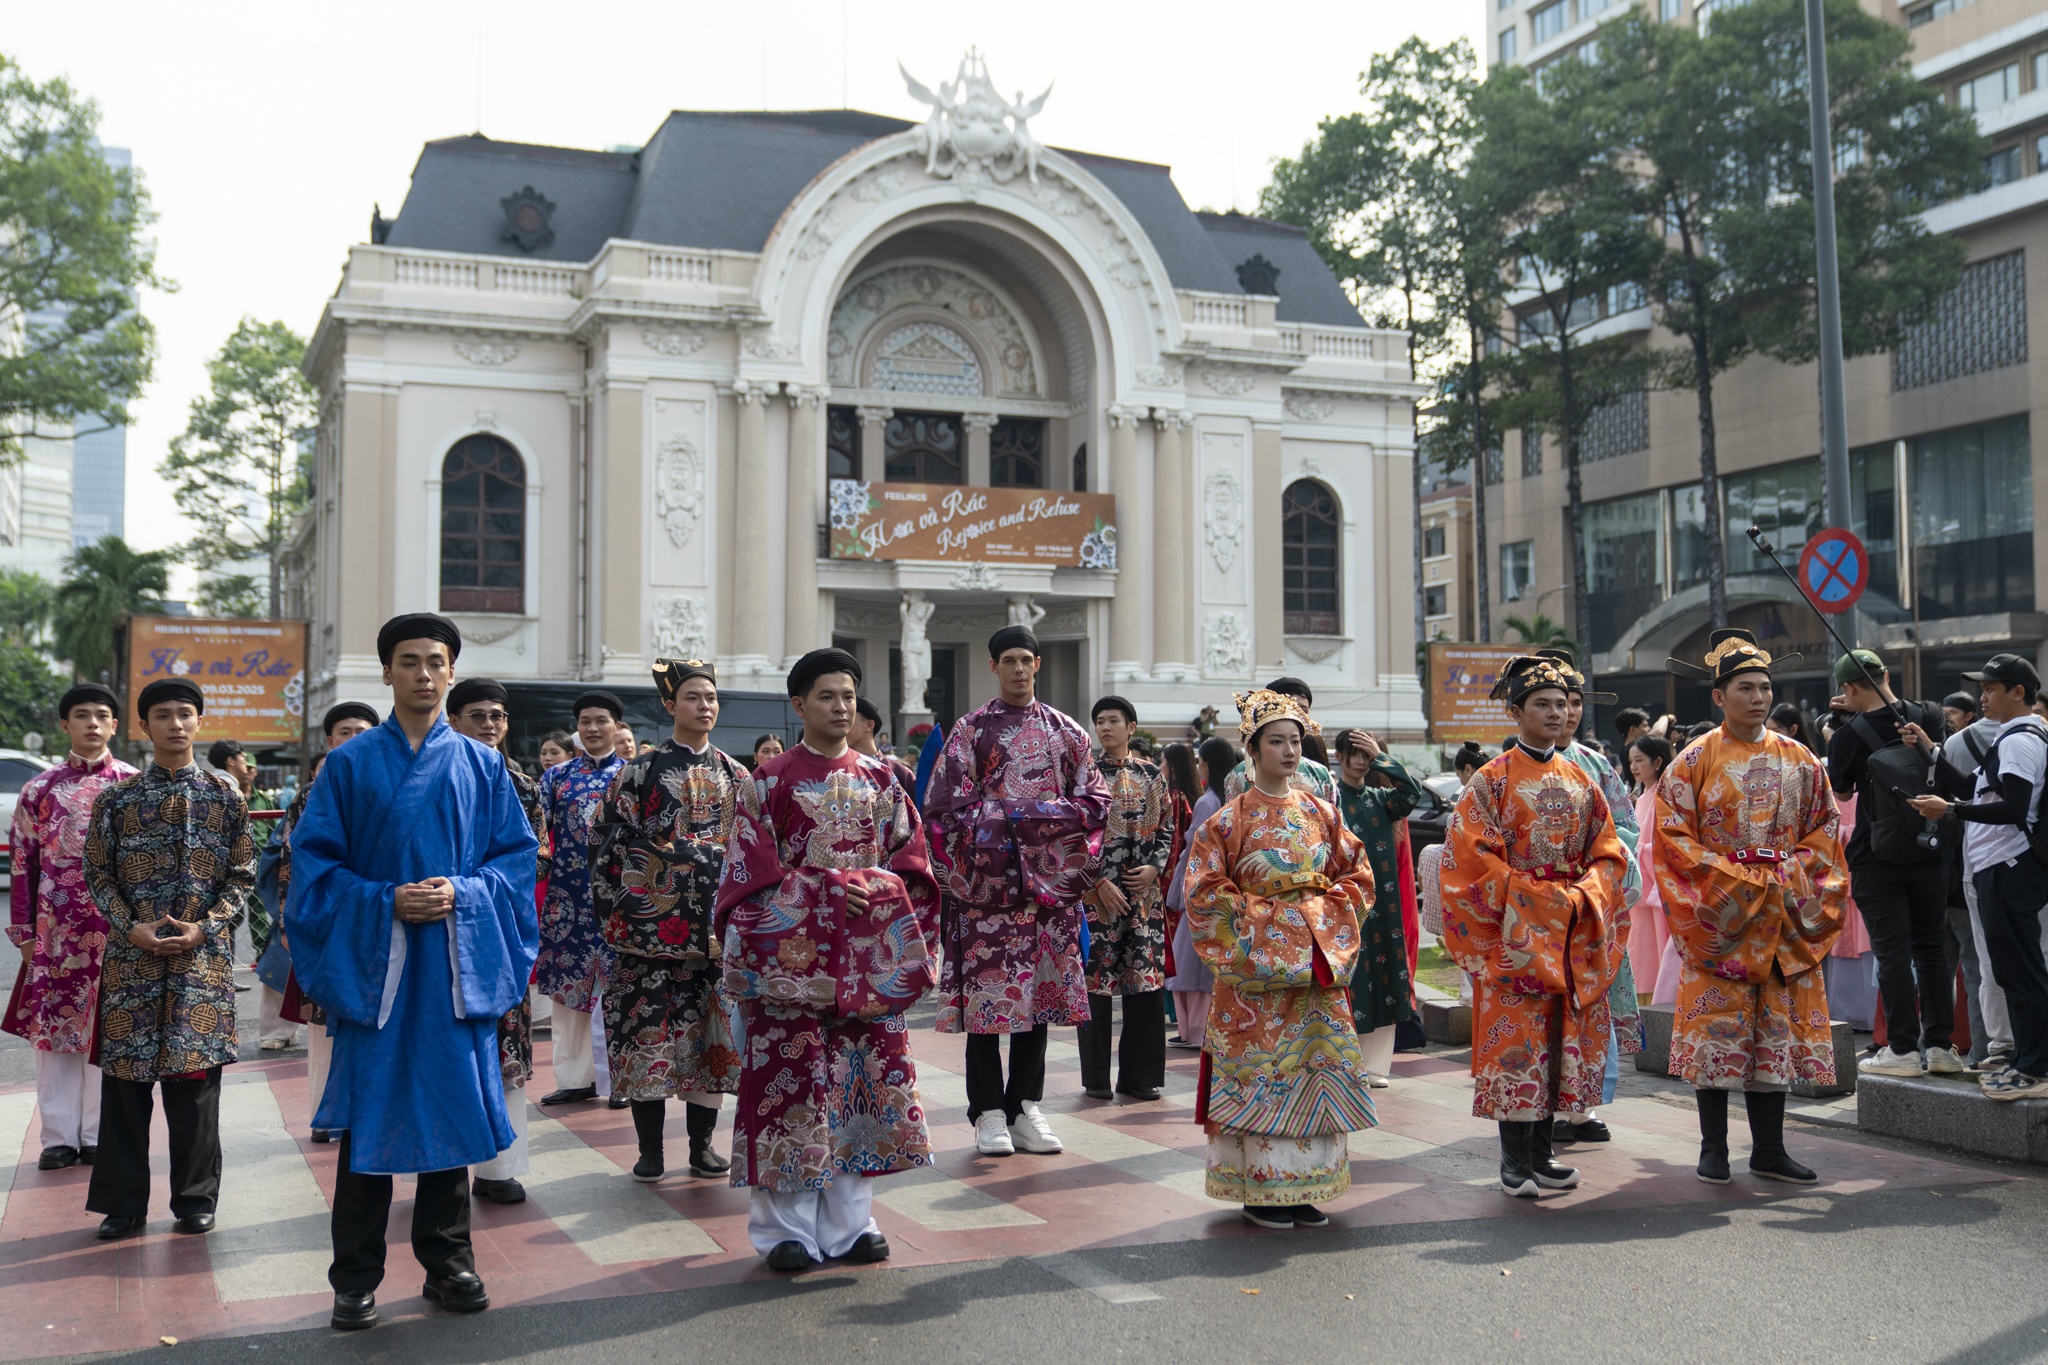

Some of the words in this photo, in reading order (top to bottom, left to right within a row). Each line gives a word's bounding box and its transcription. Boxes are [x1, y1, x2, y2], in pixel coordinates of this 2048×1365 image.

[884, 491, 928, 503] FEELINGS
[919, 507, 939, 530] và
[941, 489, 988, 523] Rác
[998, 503, 1027, 528] and
[1027, 495, 1081, 522] Refuse
[208, 656, 234, 675] và
[235, 649, 294, 678] Rác
